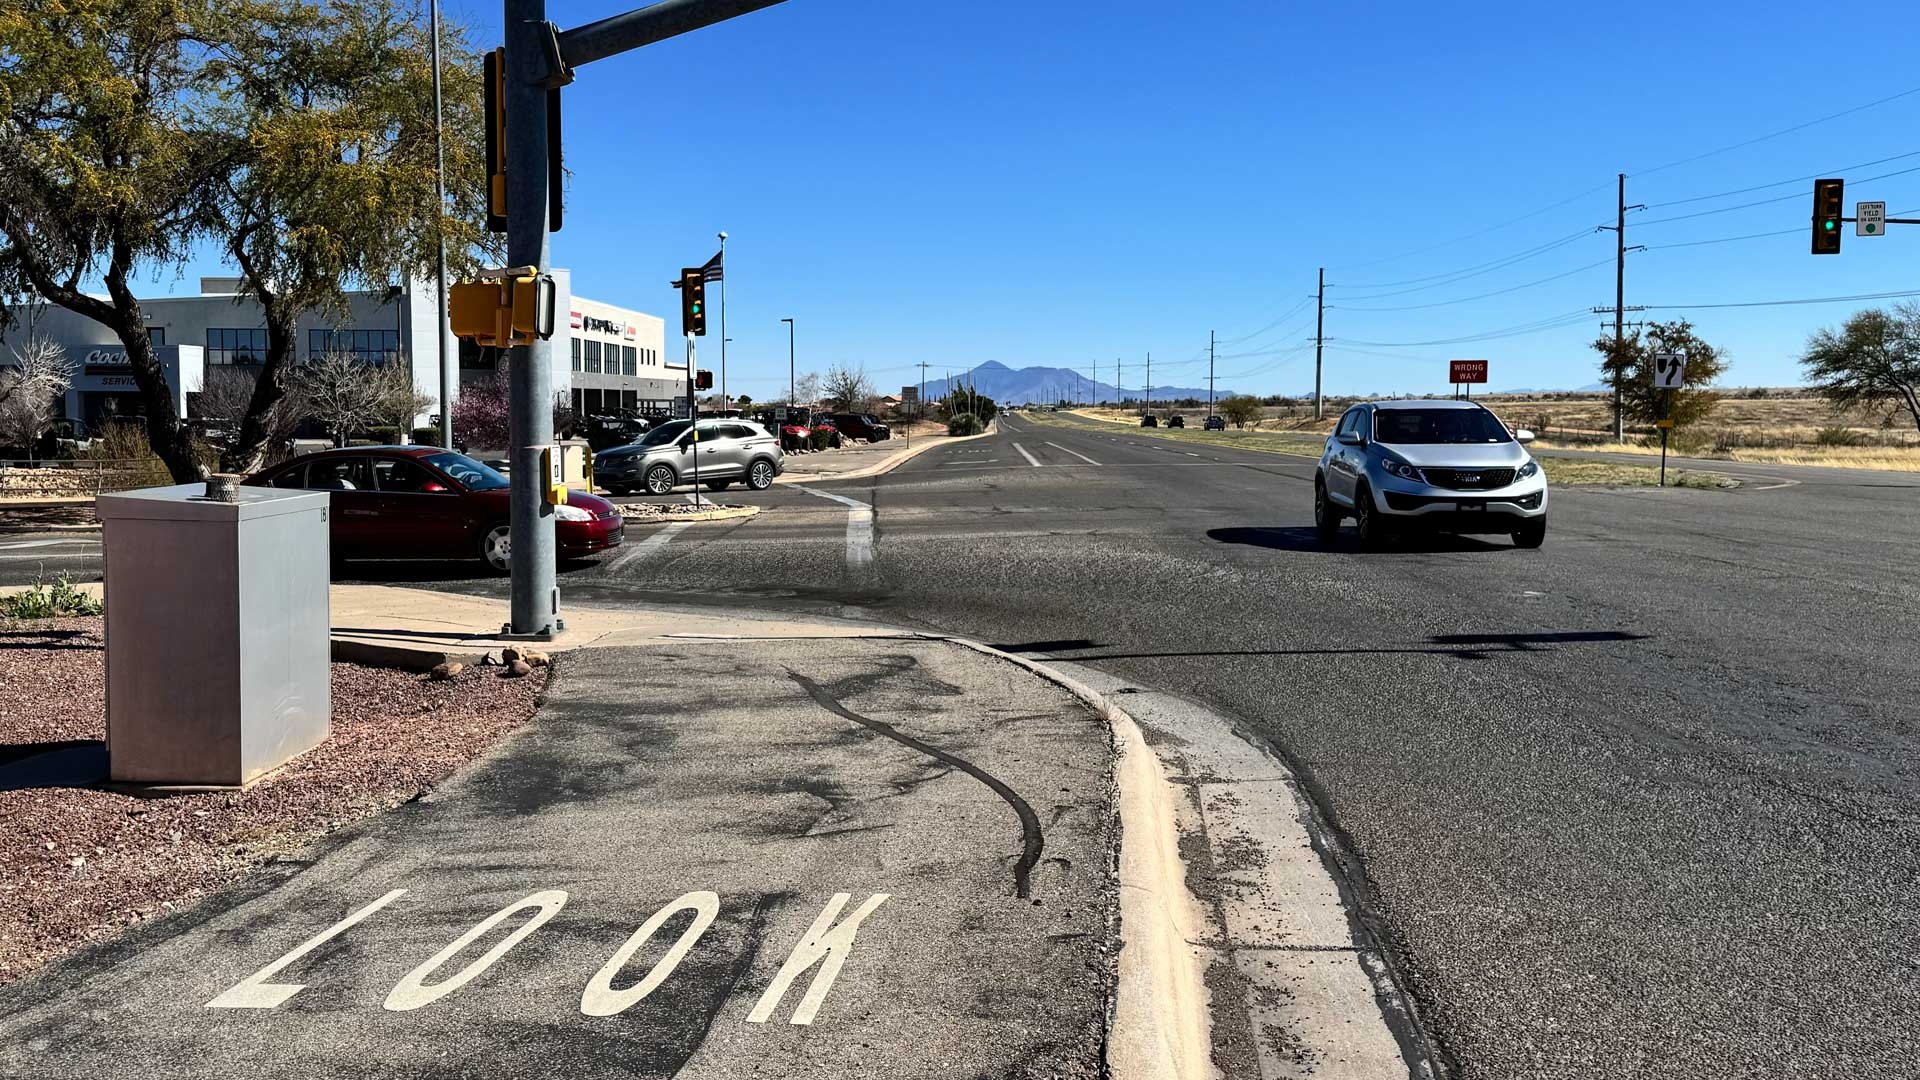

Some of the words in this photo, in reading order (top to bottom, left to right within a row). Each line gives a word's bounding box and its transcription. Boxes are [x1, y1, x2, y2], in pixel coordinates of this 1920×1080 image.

[1454, 363, 1484, 371] WRONG
[1460, 372, 1478, 380] WAY
[102, 377, 136, 386] SERVIC
[203, 889, 891, 1026] LOOK
